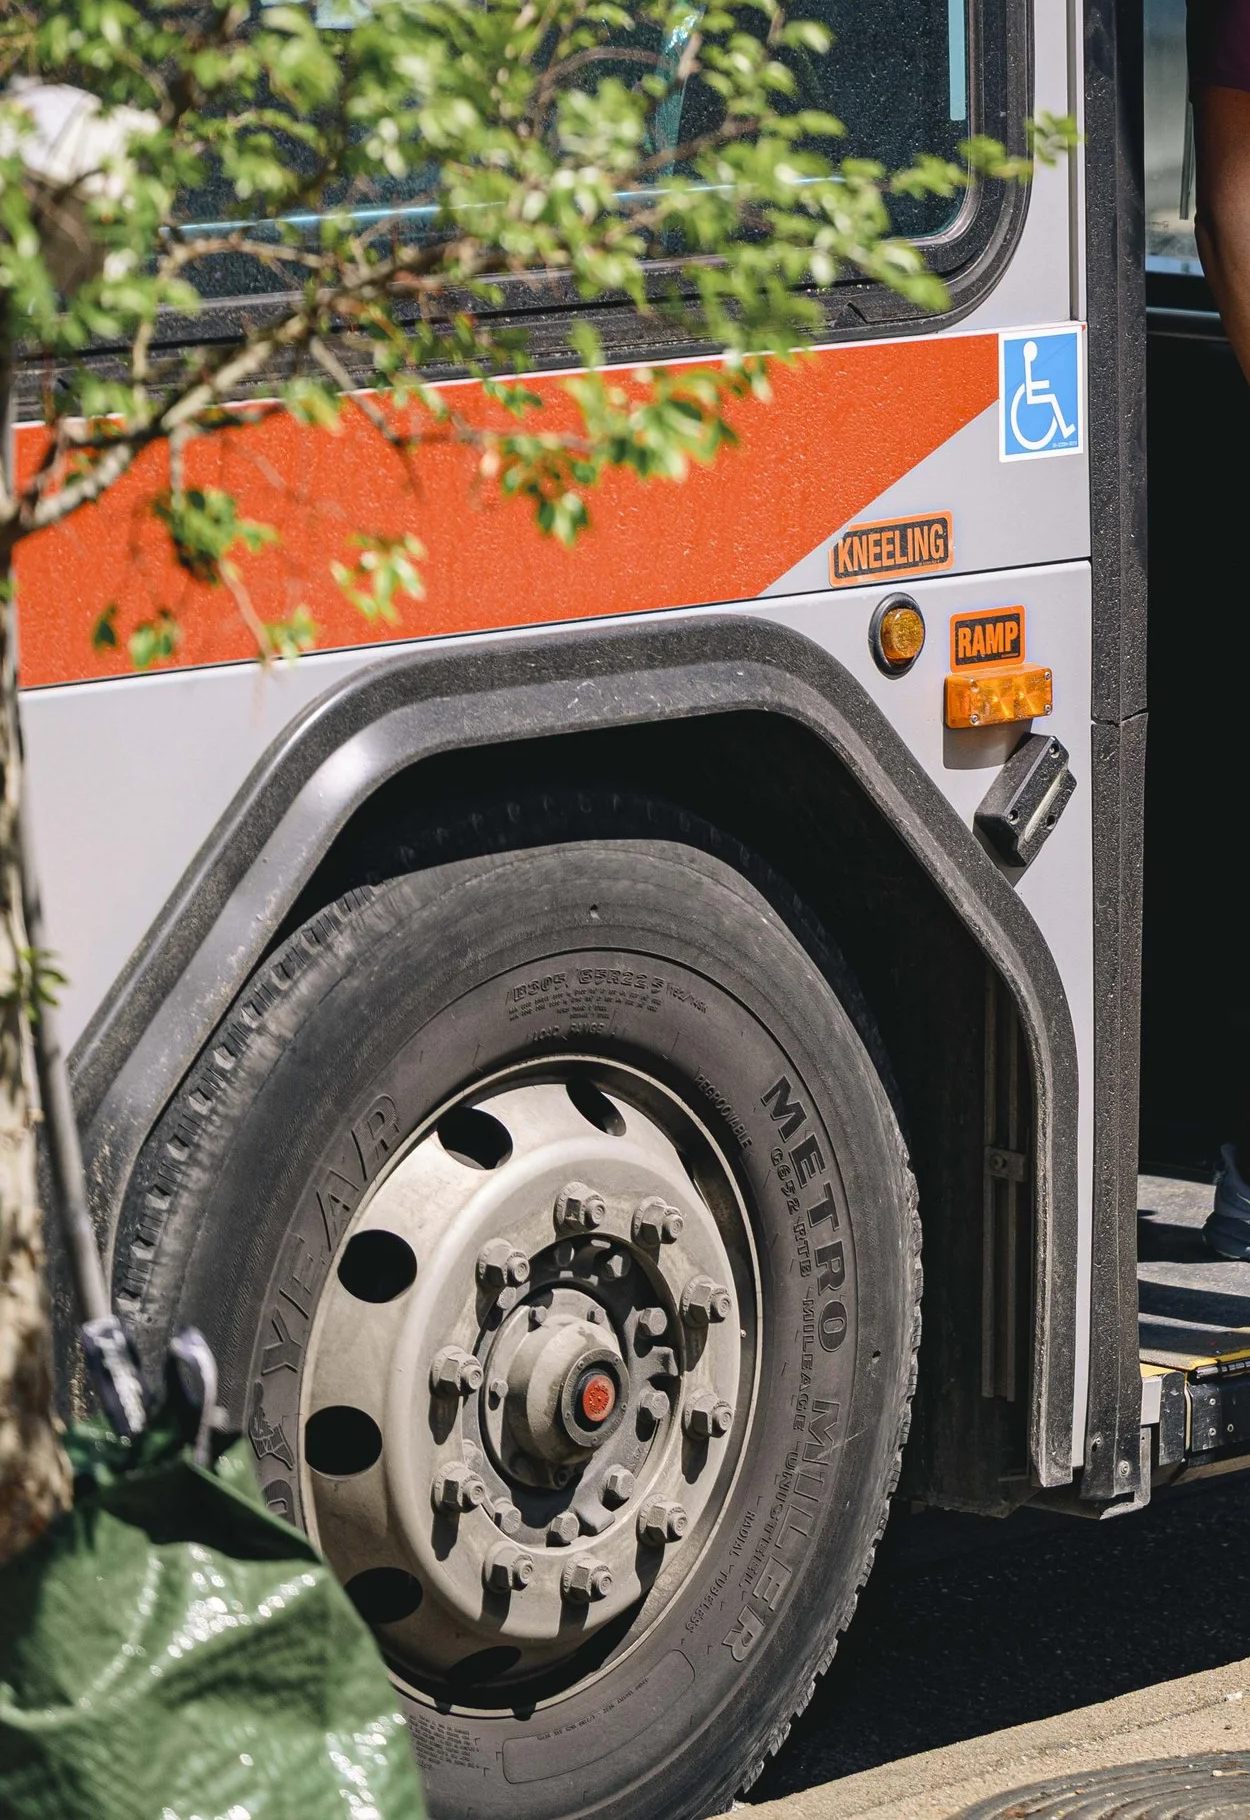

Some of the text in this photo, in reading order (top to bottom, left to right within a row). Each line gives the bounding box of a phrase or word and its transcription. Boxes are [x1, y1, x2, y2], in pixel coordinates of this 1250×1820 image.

[838, 523, 944, 574] KNEELING
[958, 621, 1018, 658] RAMP
[770, 1146, 800, 1216] G652
[792, 1298, 815, 1432] MILEAGE
[722, 1075, 848, 1663] METRO MILER
[685, 1510, 756, 1634] RADIAL TUBELESS
